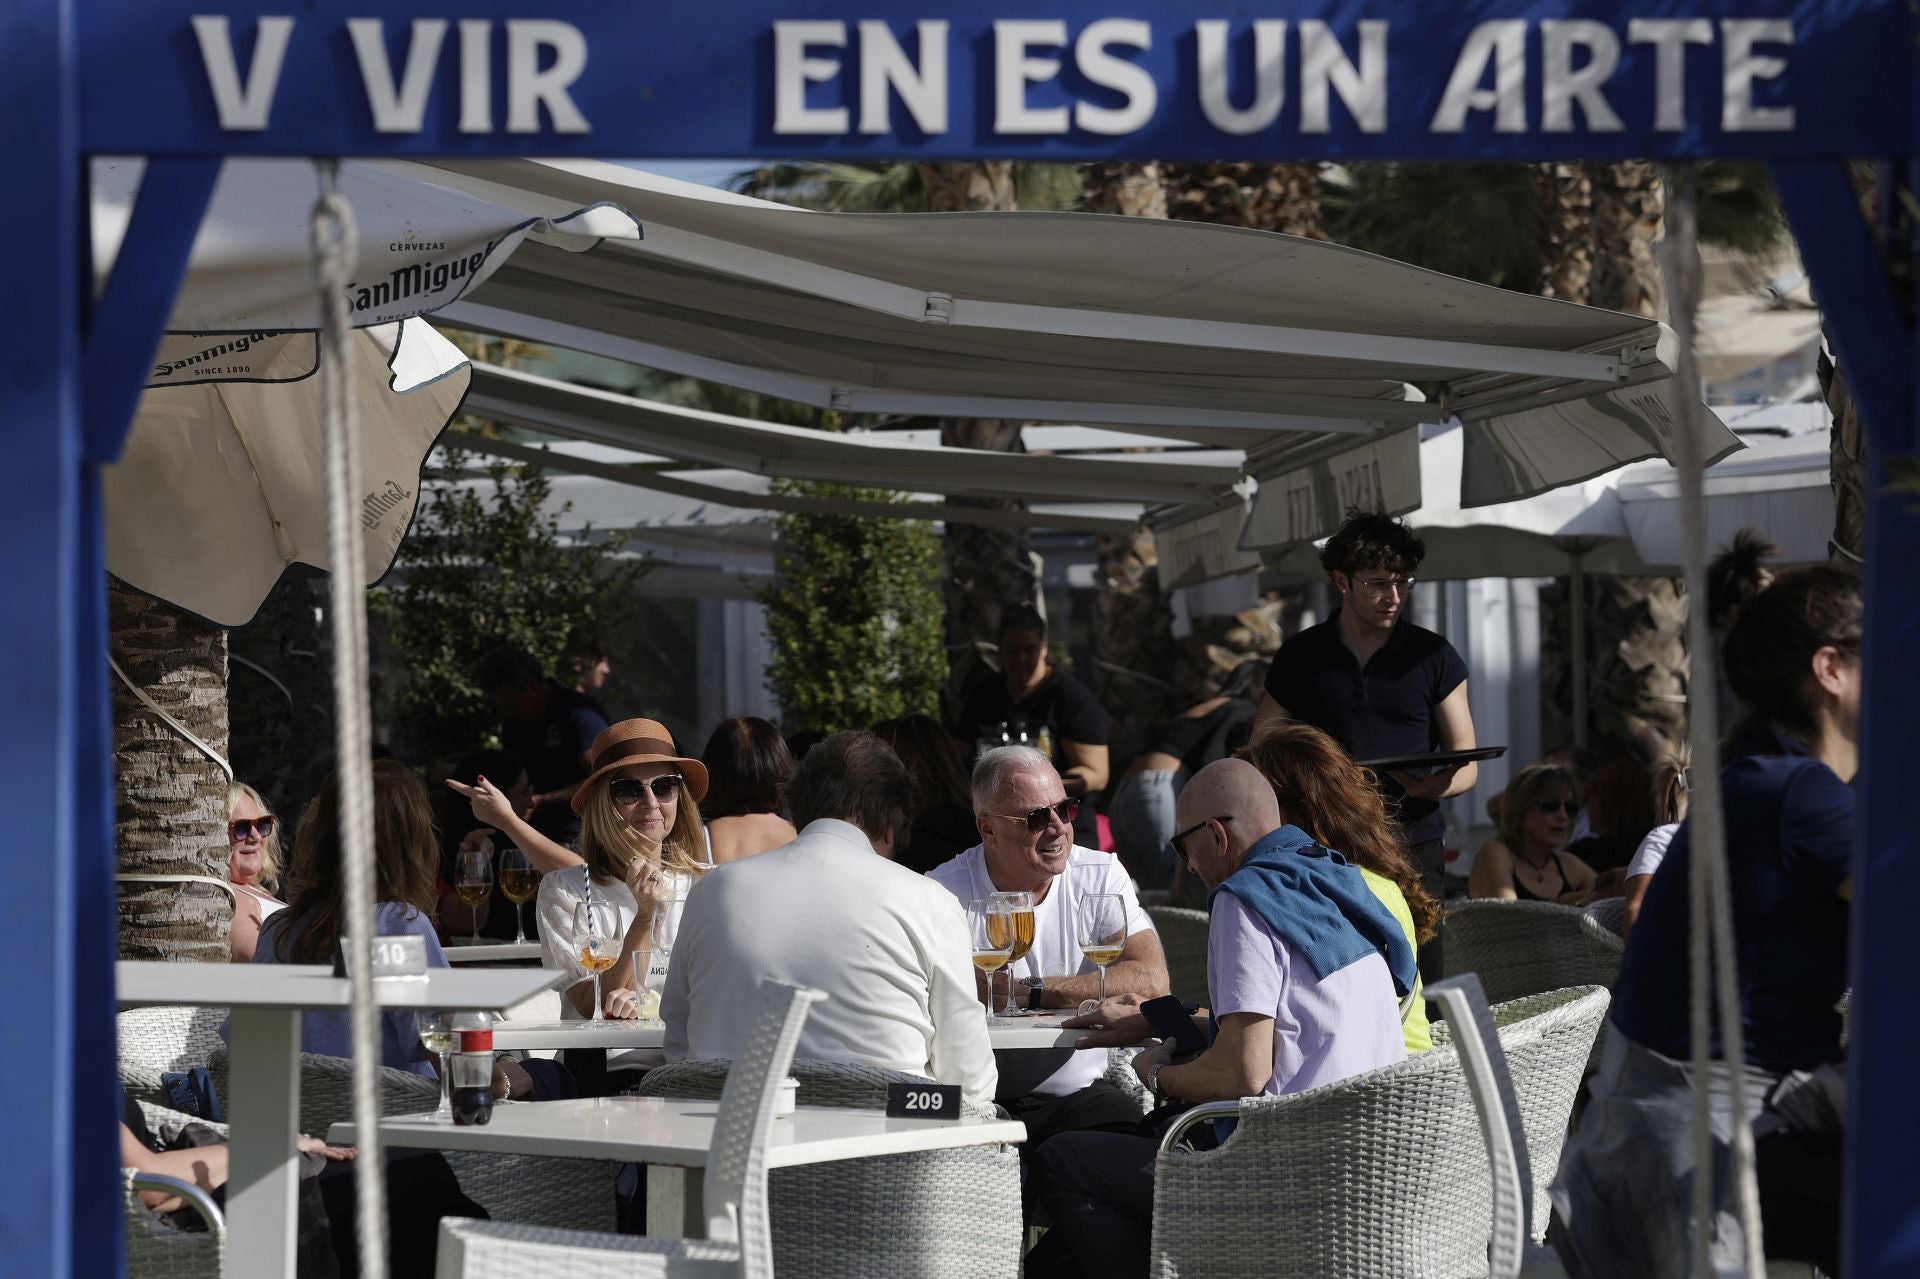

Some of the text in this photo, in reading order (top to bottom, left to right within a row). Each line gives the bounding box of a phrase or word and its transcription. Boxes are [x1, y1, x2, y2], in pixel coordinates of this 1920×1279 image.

[773, 19, 950, 135] EN
[993, 17, 1158, 135] ES
[1194, 18, 1388, 134] UN
[1430, 18, 1796, 132] ARTE
[389, 242, 446, 252] CERVEZAS
[194, 365, 250, 376] SINCE 1890
[905, 1091, 943, 1111] 209
